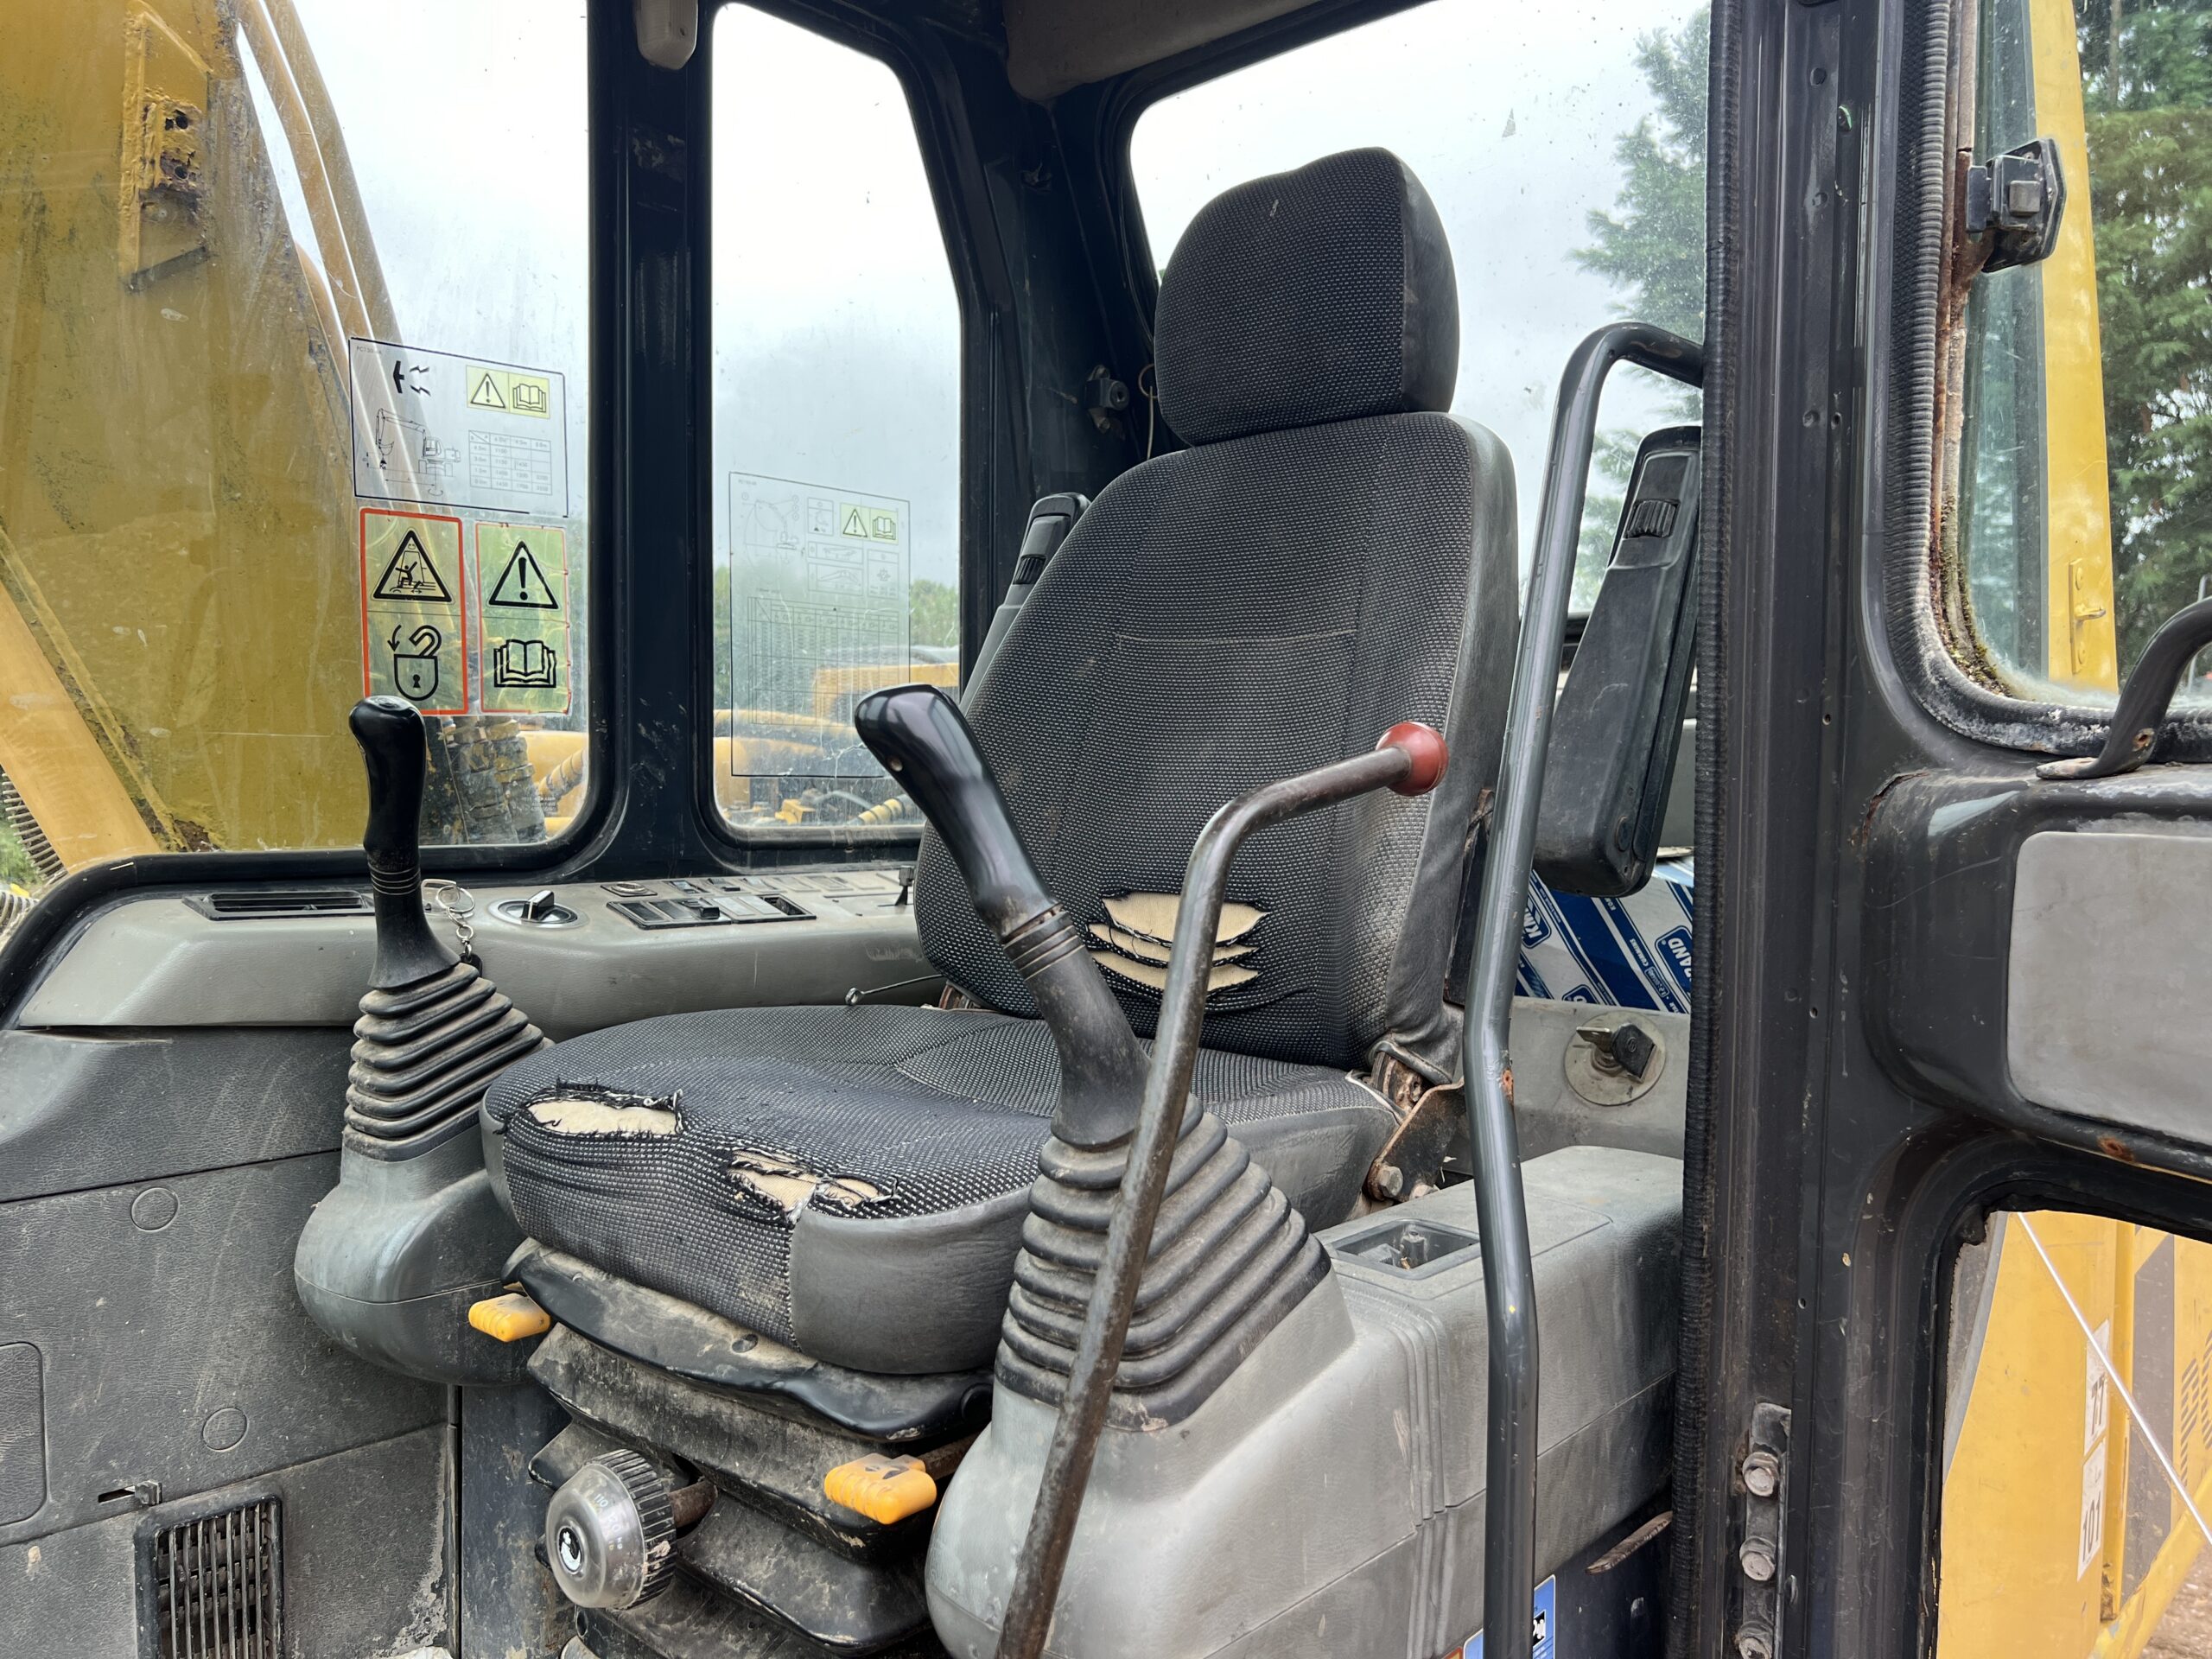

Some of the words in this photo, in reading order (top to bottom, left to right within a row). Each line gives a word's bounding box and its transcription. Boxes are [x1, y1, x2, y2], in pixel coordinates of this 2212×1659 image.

[1523, 907, 1542, 938] KM
[1629, 938, 1649, 967] CUMMINS
[1668, 938, 1691, 980] RAND
[594, 1493, 609, 1508] 110
[2082, 1491, 2101, 1562] 101
